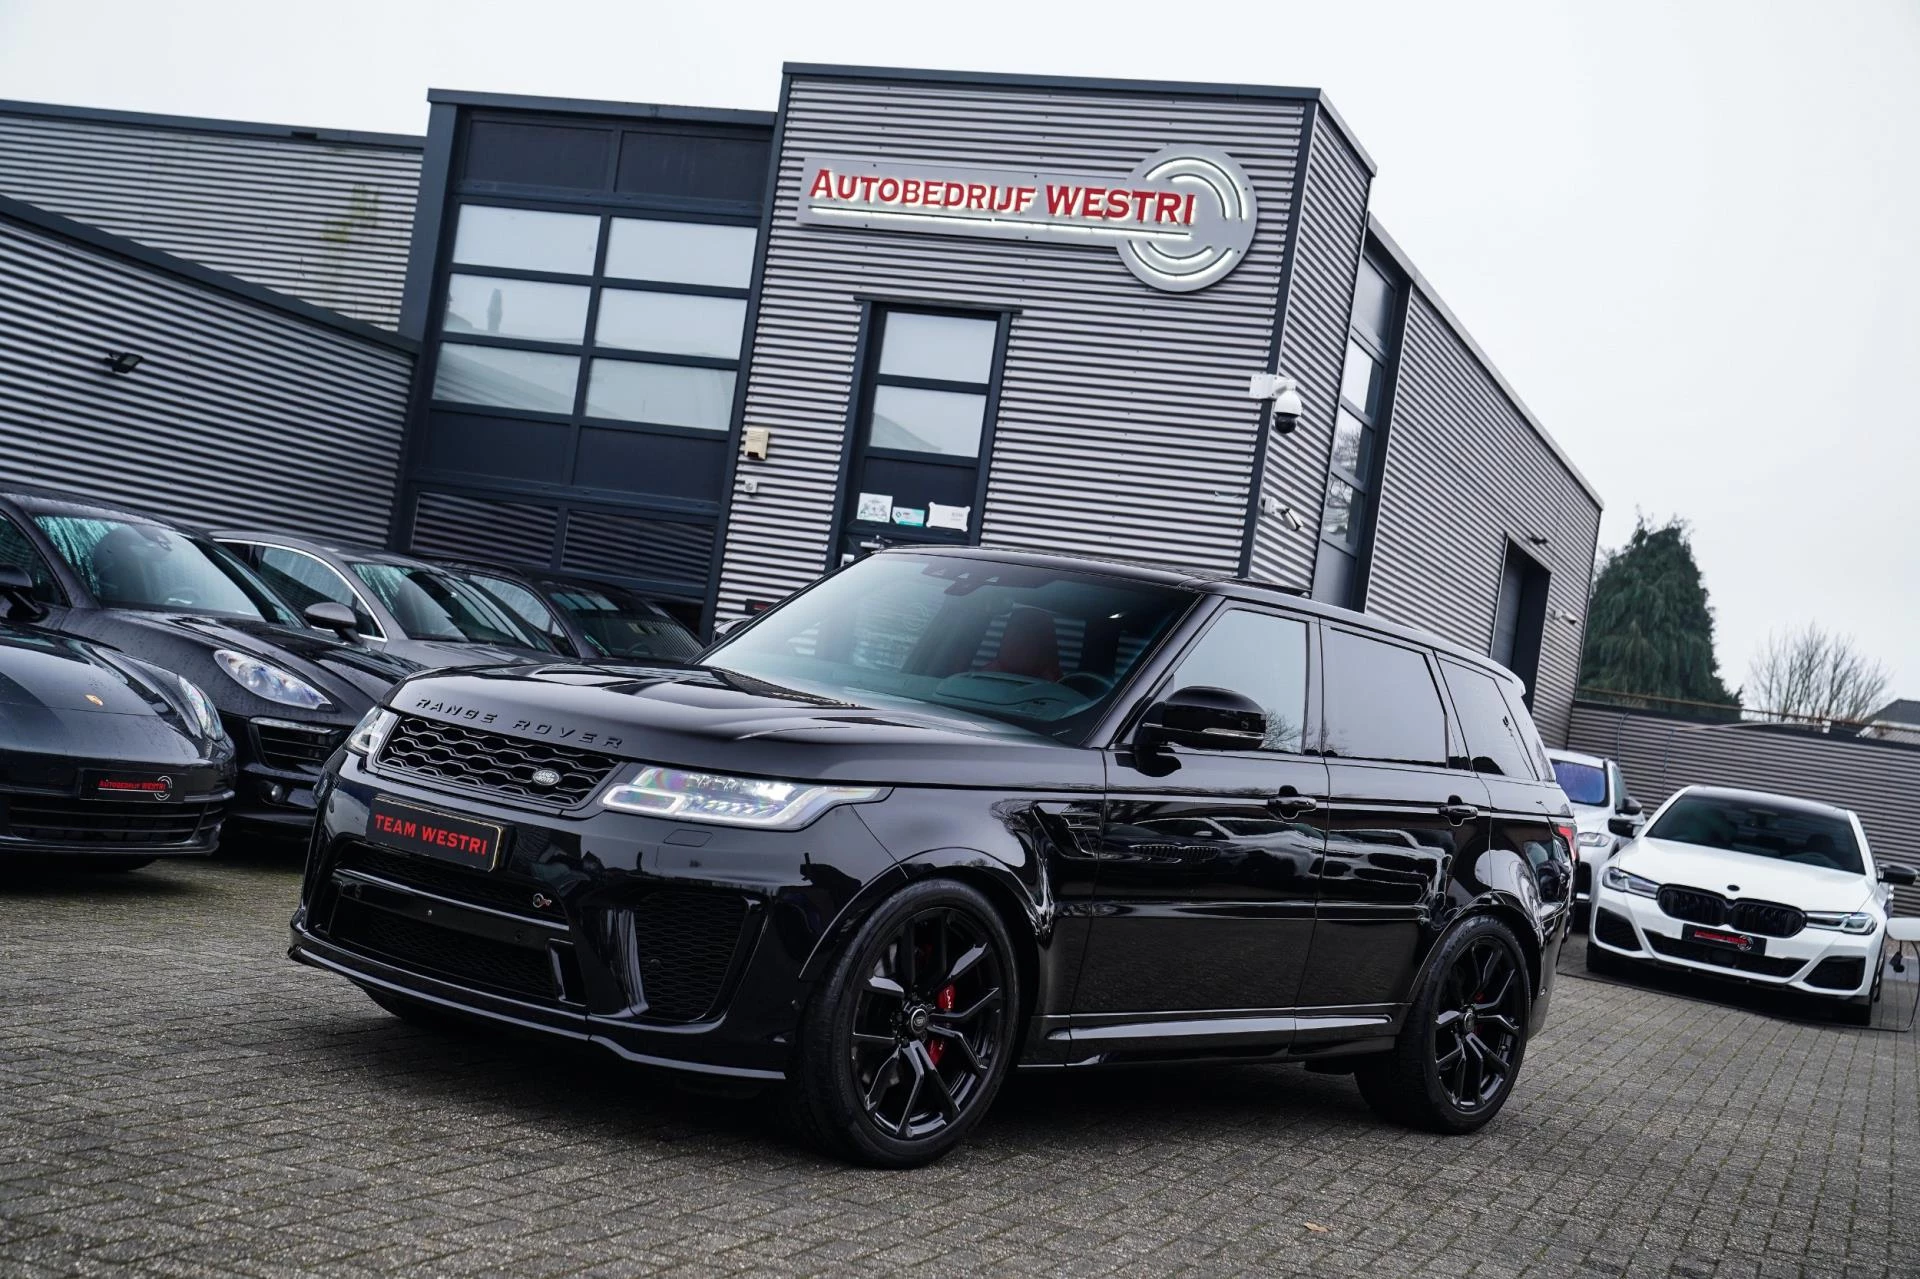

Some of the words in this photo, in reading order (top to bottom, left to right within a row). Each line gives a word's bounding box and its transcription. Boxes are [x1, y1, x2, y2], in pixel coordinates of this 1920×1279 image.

[809, 169, 1036, 212] AUTOBEDRIJF
[1046, 184, 1195, 225] WESTRI
[415, 698, 498, 724] RANGE
[512, 719, 625, 749] ROVER
[375, 814, 417, 837] TEAM
[421, 826, 488, 856] WESTRI
